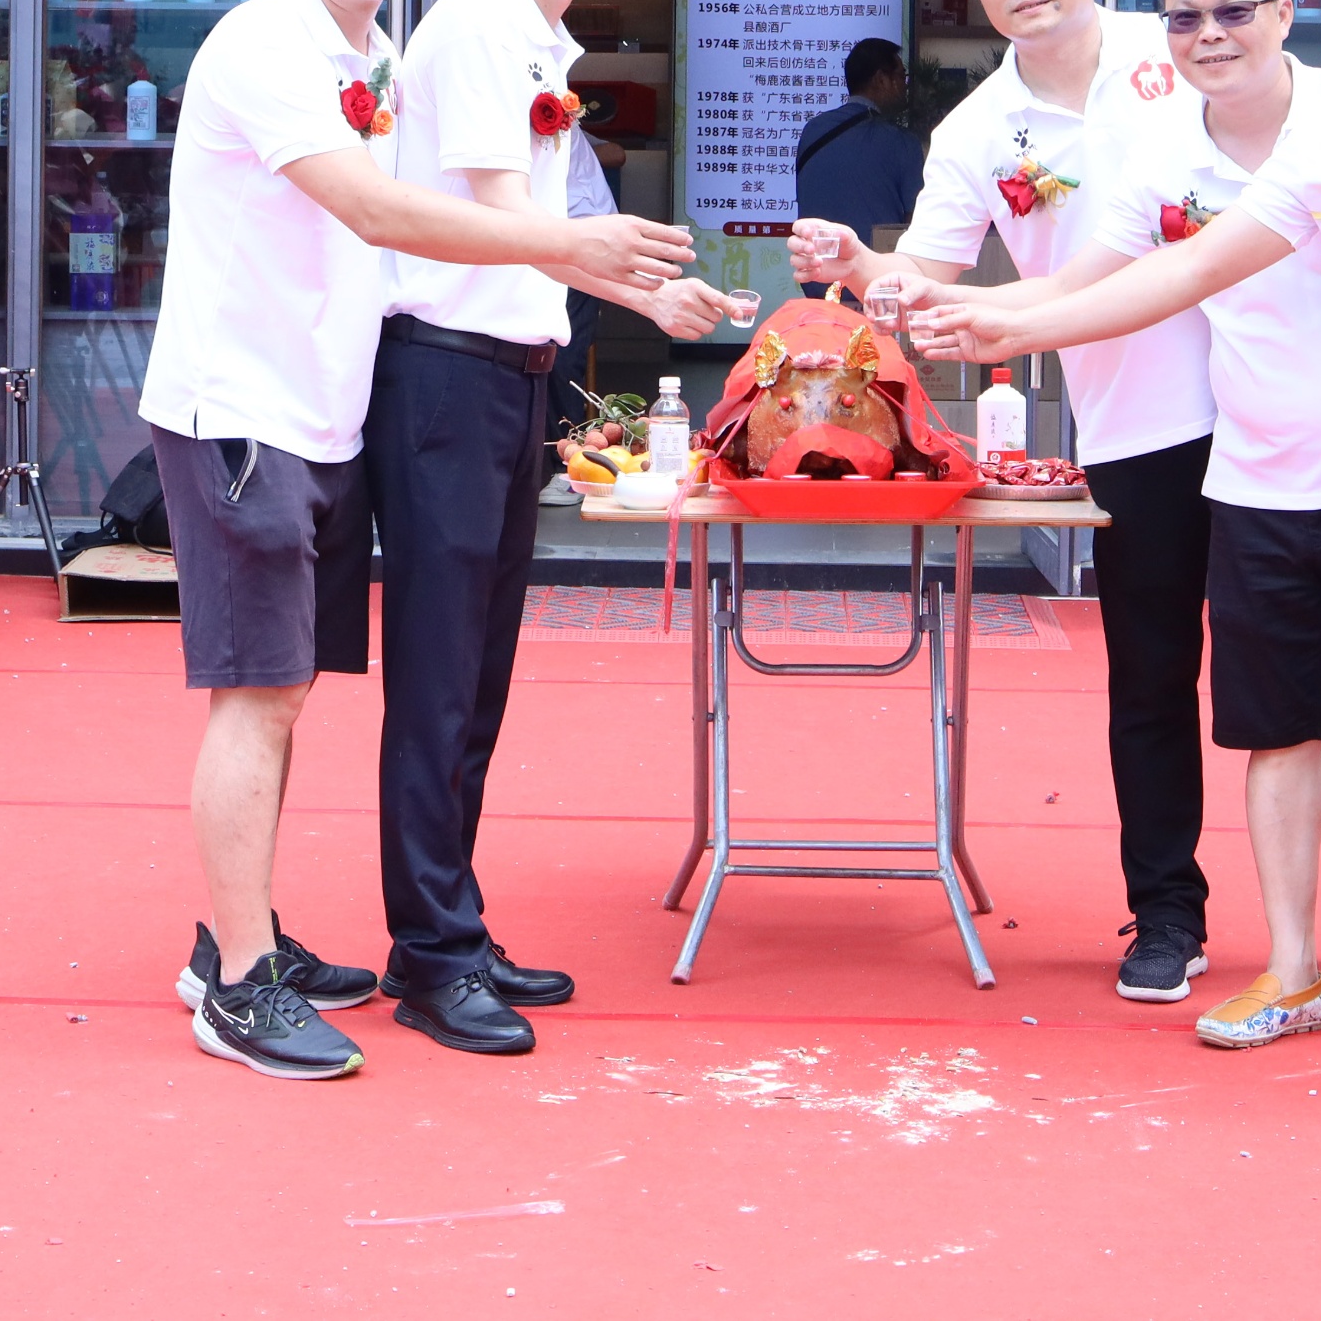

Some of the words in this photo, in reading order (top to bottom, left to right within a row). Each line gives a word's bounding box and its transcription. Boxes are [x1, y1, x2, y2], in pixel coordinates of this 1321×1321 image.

[698, 2, 740, 13] 1956年
[743, 4, 890, 17] 公私合营成立地方国营吴川
[743, 21, 791, 33] 县酿酒厂
[698, 38, 740, 50] 1974年
[697, 91, 739, 103] 1978年
[697, 109, 739, 120] 1980年
[697, 127, 739, 138] 1987年
[696, 144, 738, 156] 1988年
[696, 162, 738, 173] 1989年
[741, 181, 765, 193] 金奖
[696, 198, 738, 210] 1992年
